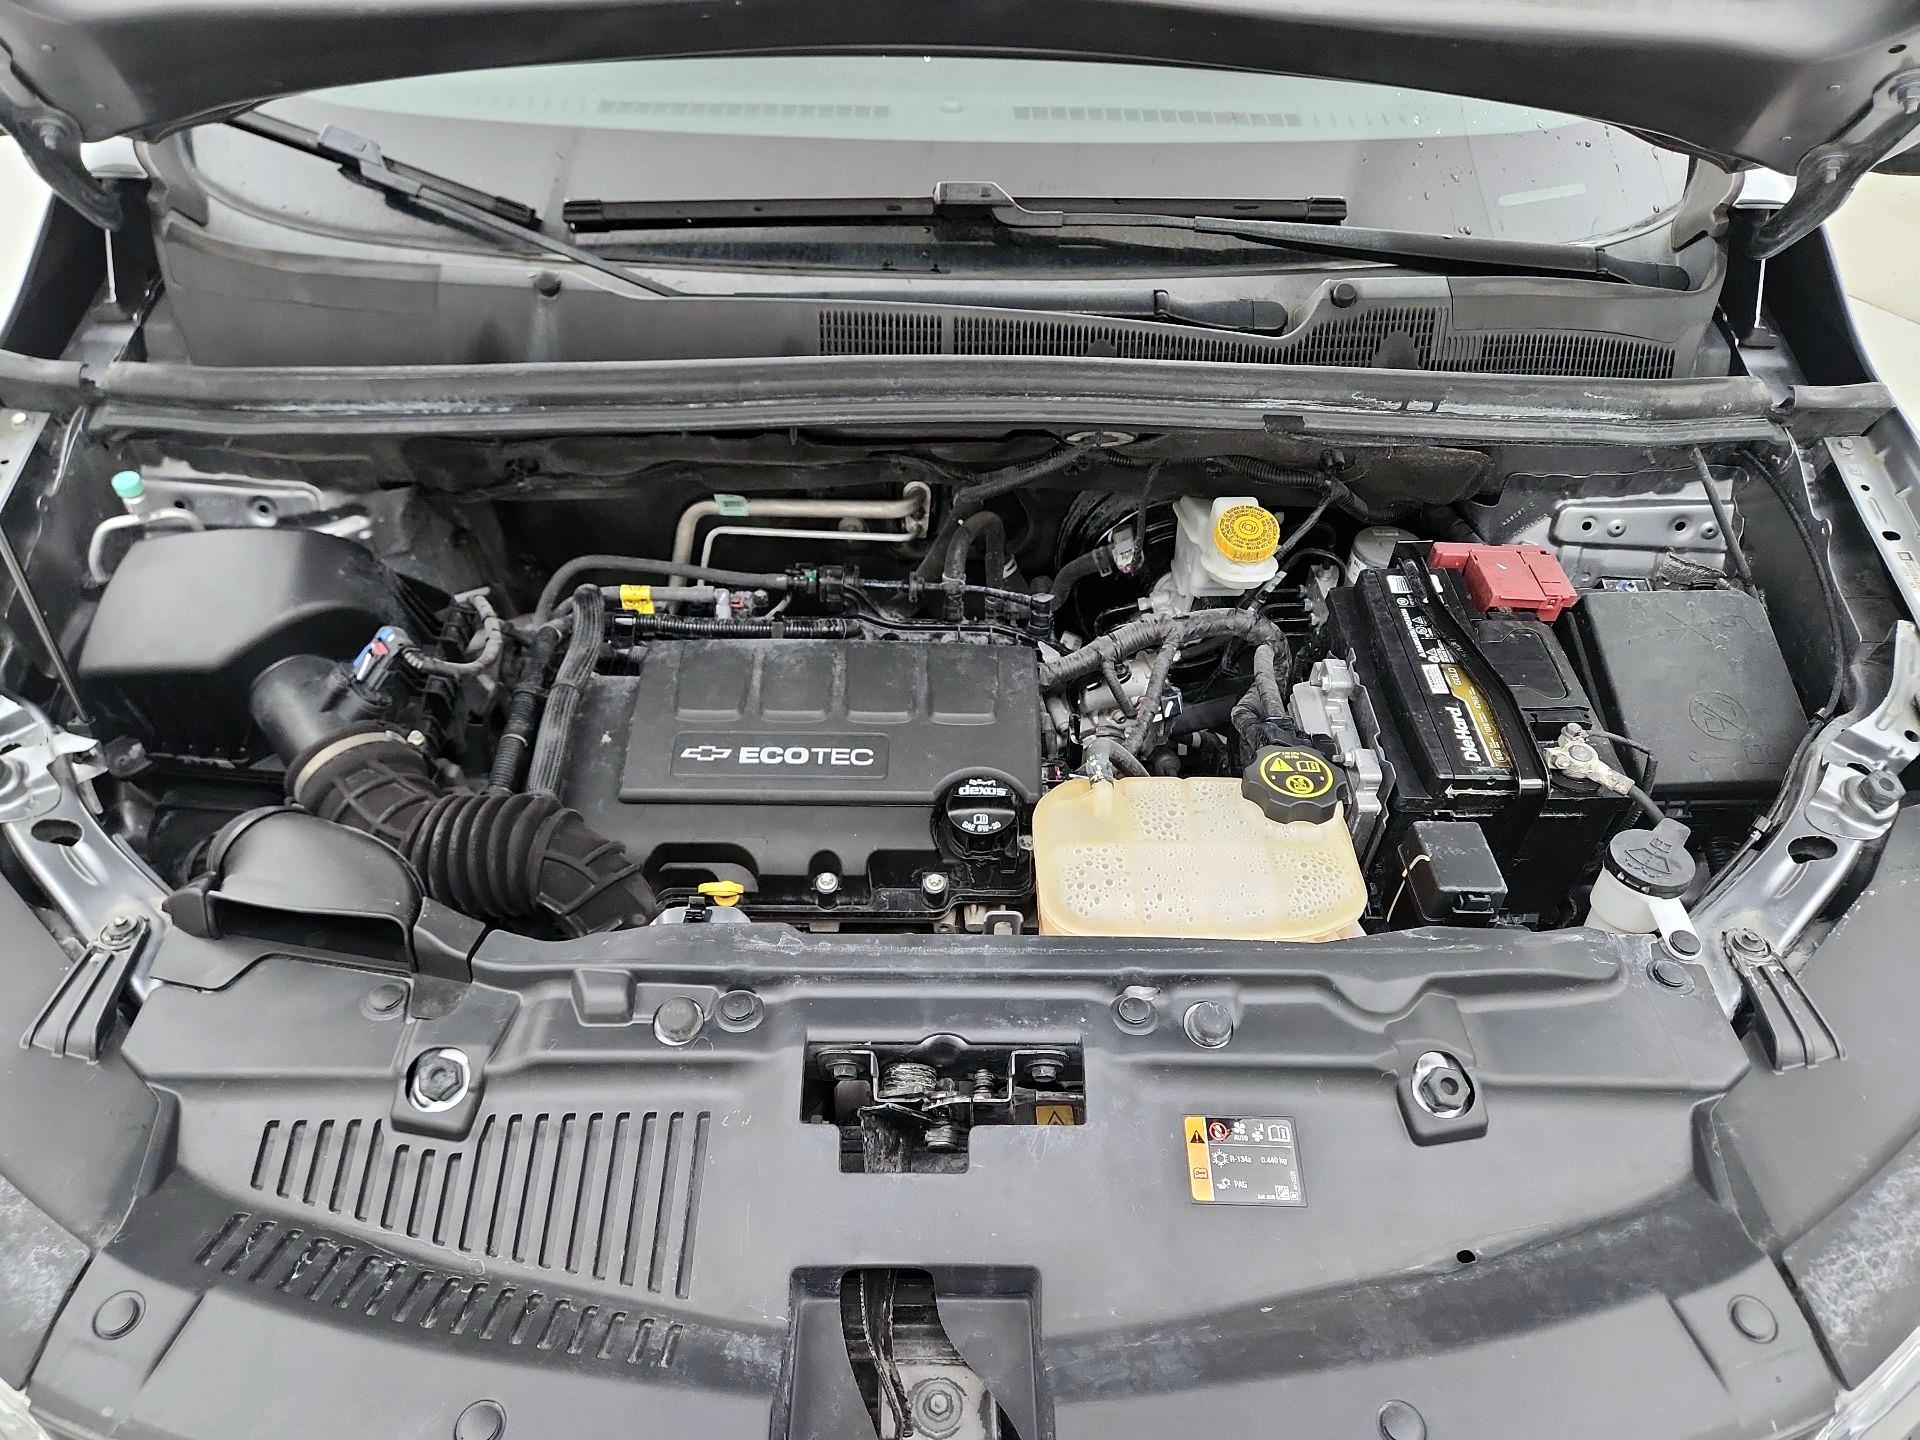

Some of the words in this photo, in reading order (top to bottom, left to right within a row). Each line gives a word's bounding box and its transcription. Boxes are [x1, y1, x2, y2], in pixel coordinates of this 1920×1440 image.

[1447, 667, 1462, 685] GOLD
[1444, 706, 1482, 761] DieHard
[738, 746, 874, 766] ECOTEC
[958, 785, 1008, 796] dexos
[962, 821, 976, 831] SAE
[1234, 1134, 1249, 1142] AUTO
[1230, 1155, 1252, 1163] R-134a
[1261, 1156, 1278, 1165] 0.440
[1279, 1156, 1288, 1165] kg
[1234, 1180, 1248, 1189] PAG
